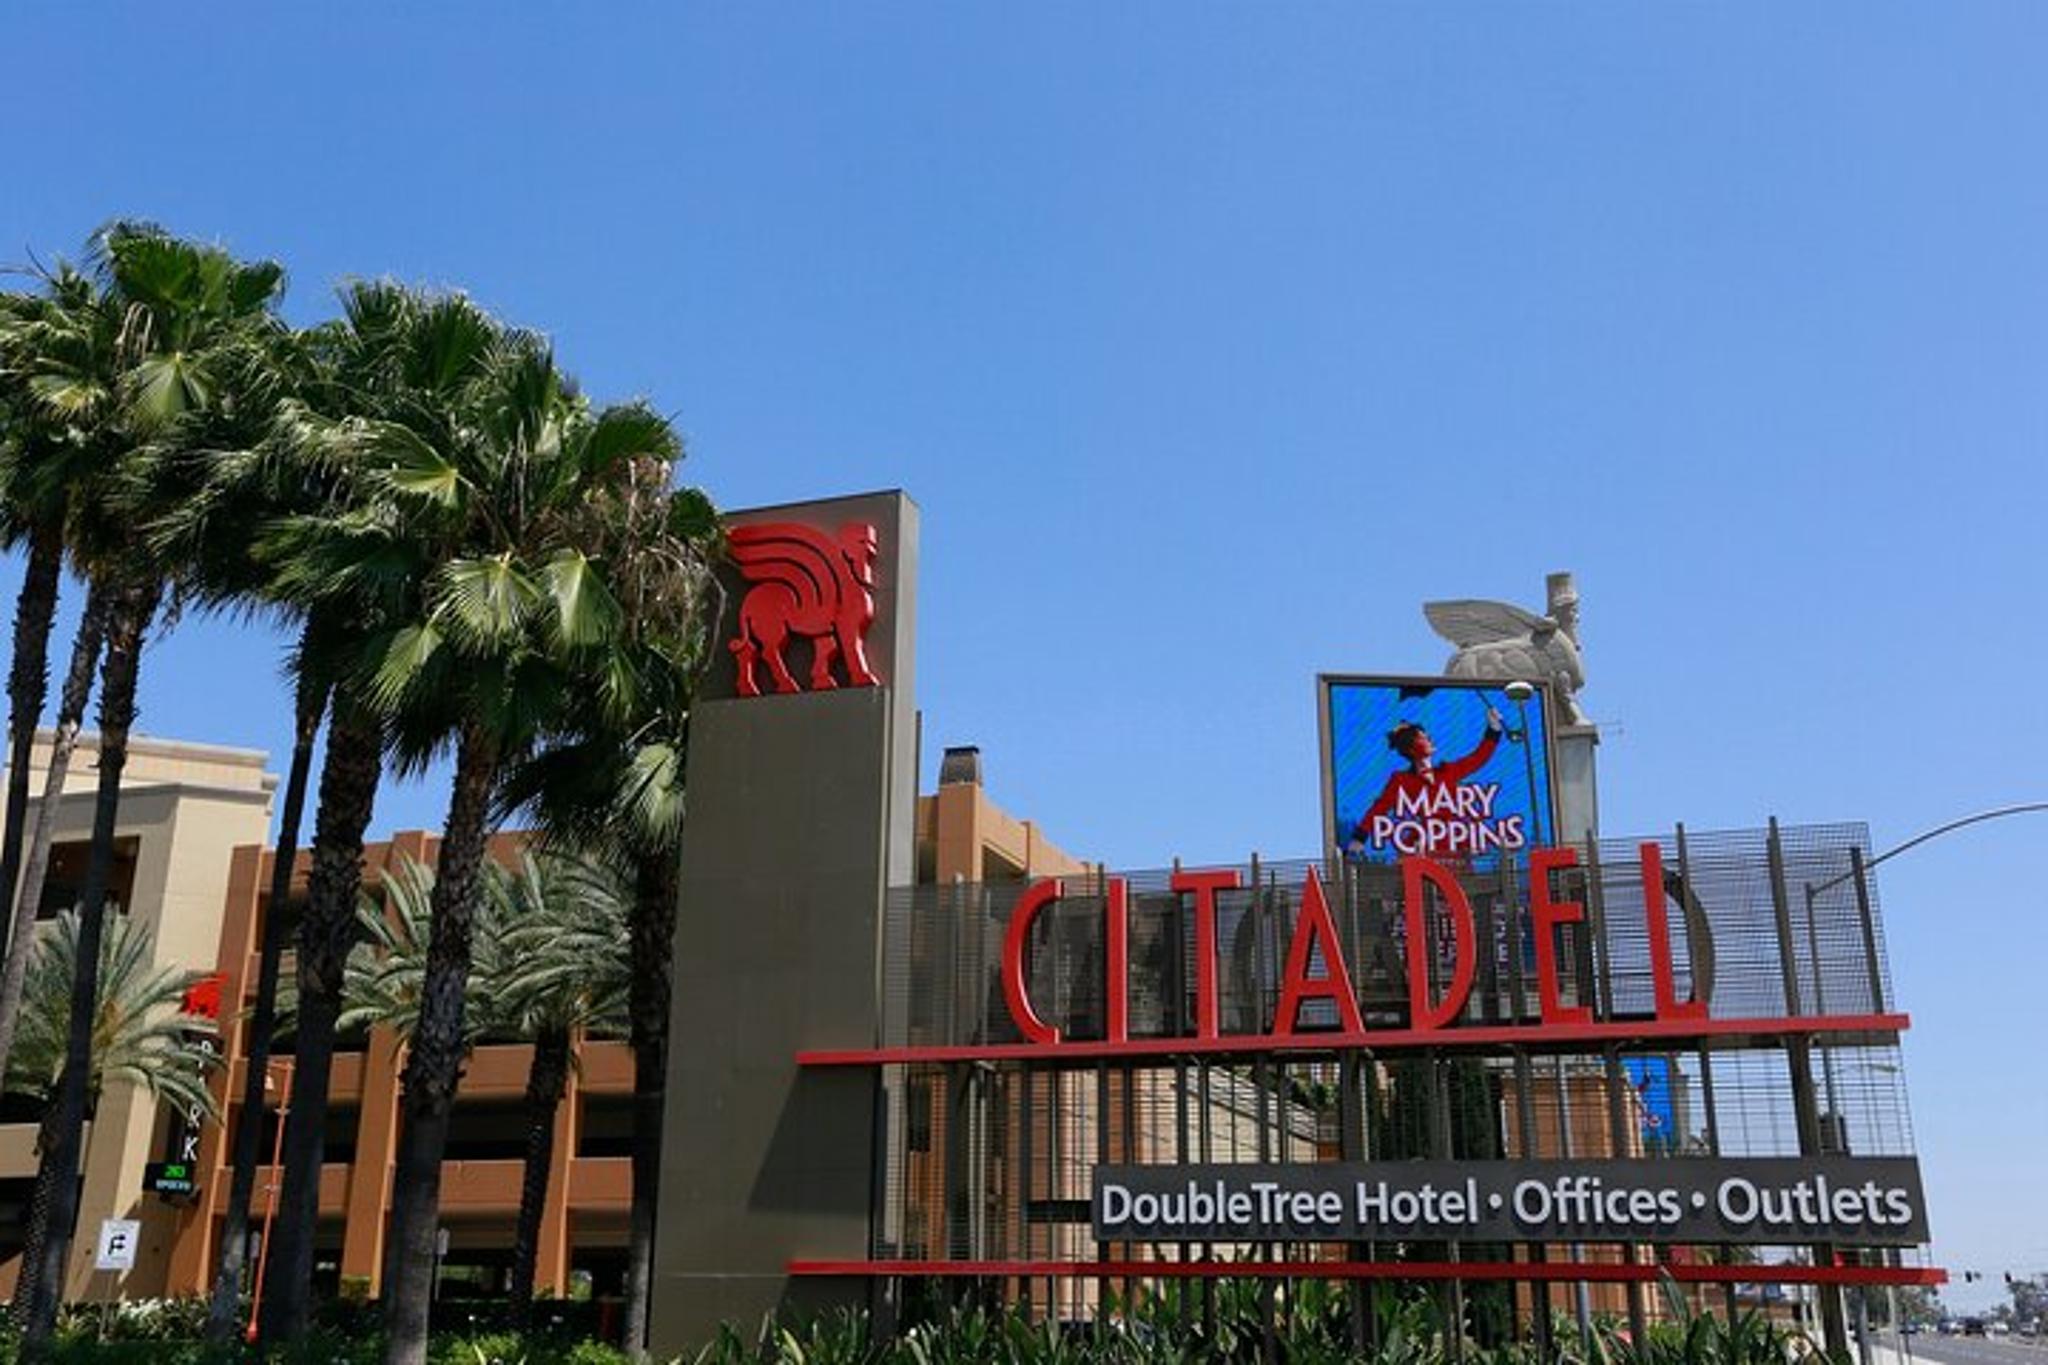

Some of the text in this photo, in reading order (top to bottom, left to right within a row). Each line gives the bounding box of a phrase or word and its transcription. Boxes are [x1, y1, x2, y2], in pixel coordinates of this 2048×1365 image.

[1396, 781, 1498, 818] MARY
[1373, 815, 1525, 855] POPPINS
[1001, 842, 1710, 1046] CITADEL
[1102, 1174, 1913, 1225] DoubleTree Hotel Offices Outlets
